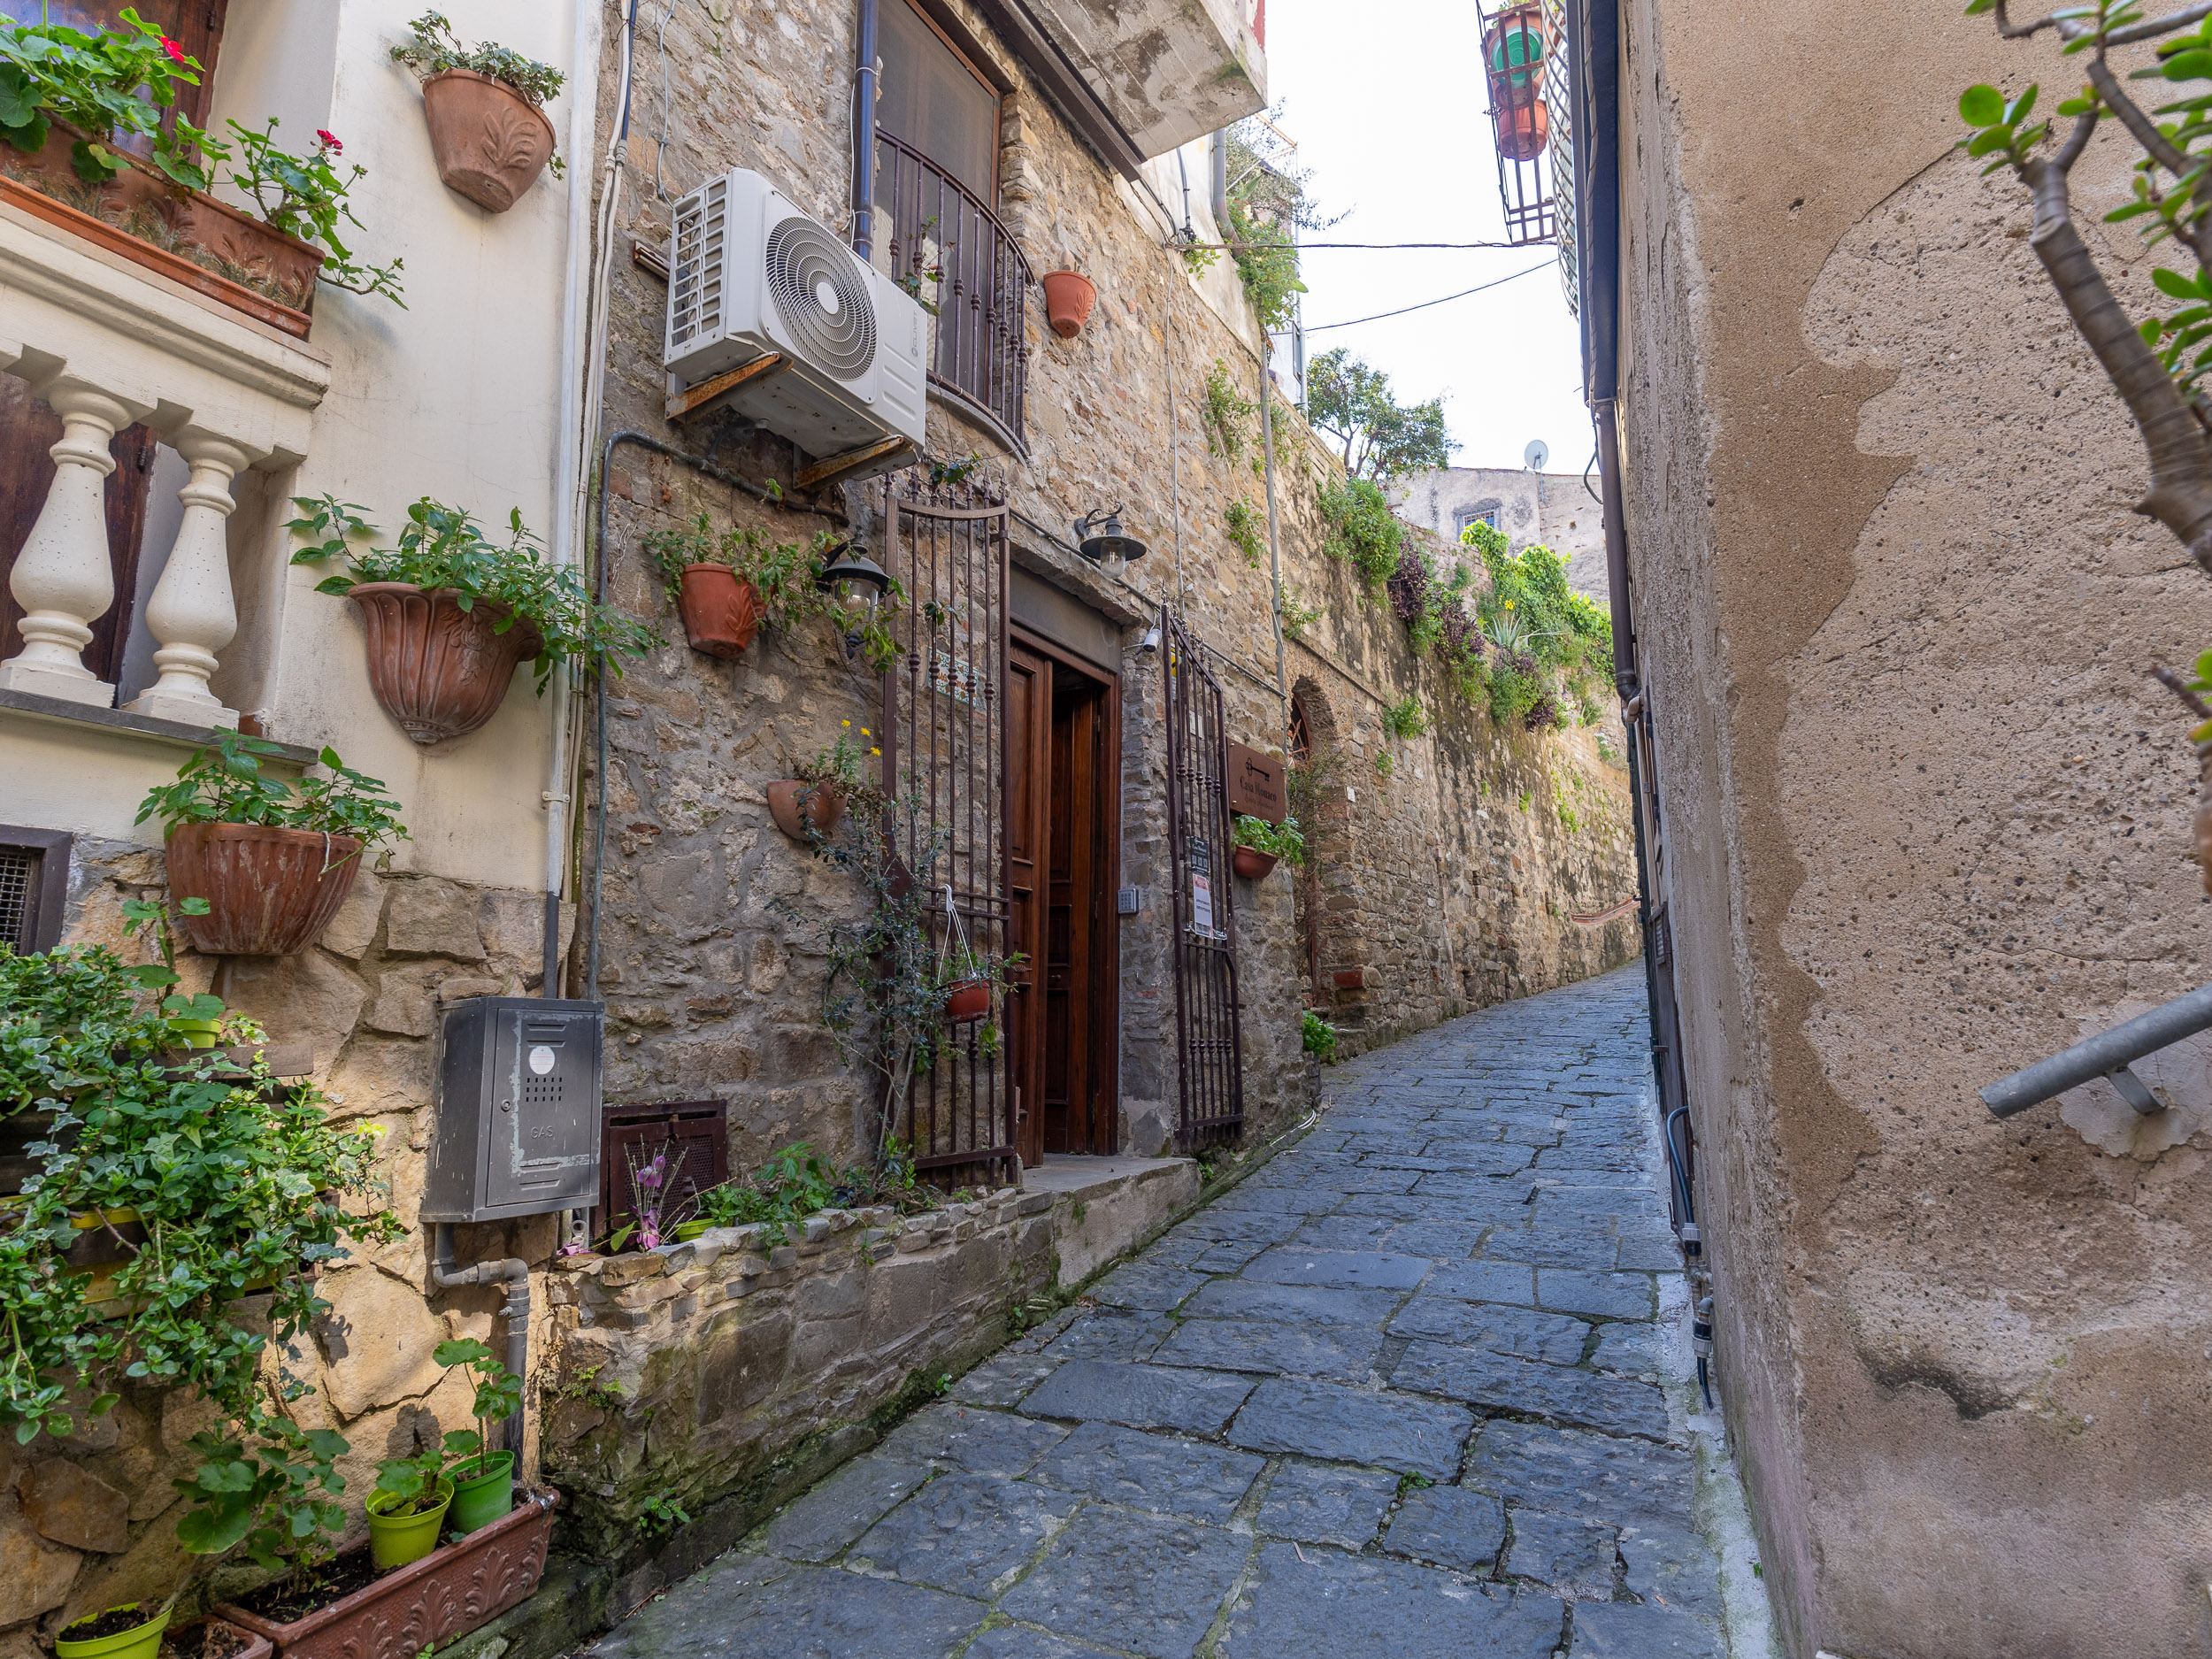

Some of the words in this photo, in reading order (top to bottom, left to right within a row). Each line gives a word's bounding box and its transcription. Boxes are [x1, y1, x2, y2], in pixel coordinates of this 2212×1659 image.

[1240, 775, 1254, 793] Casa
[1255, 782, 1277, 803] Monaco
[531, 1125, 554, 1139] GAS
